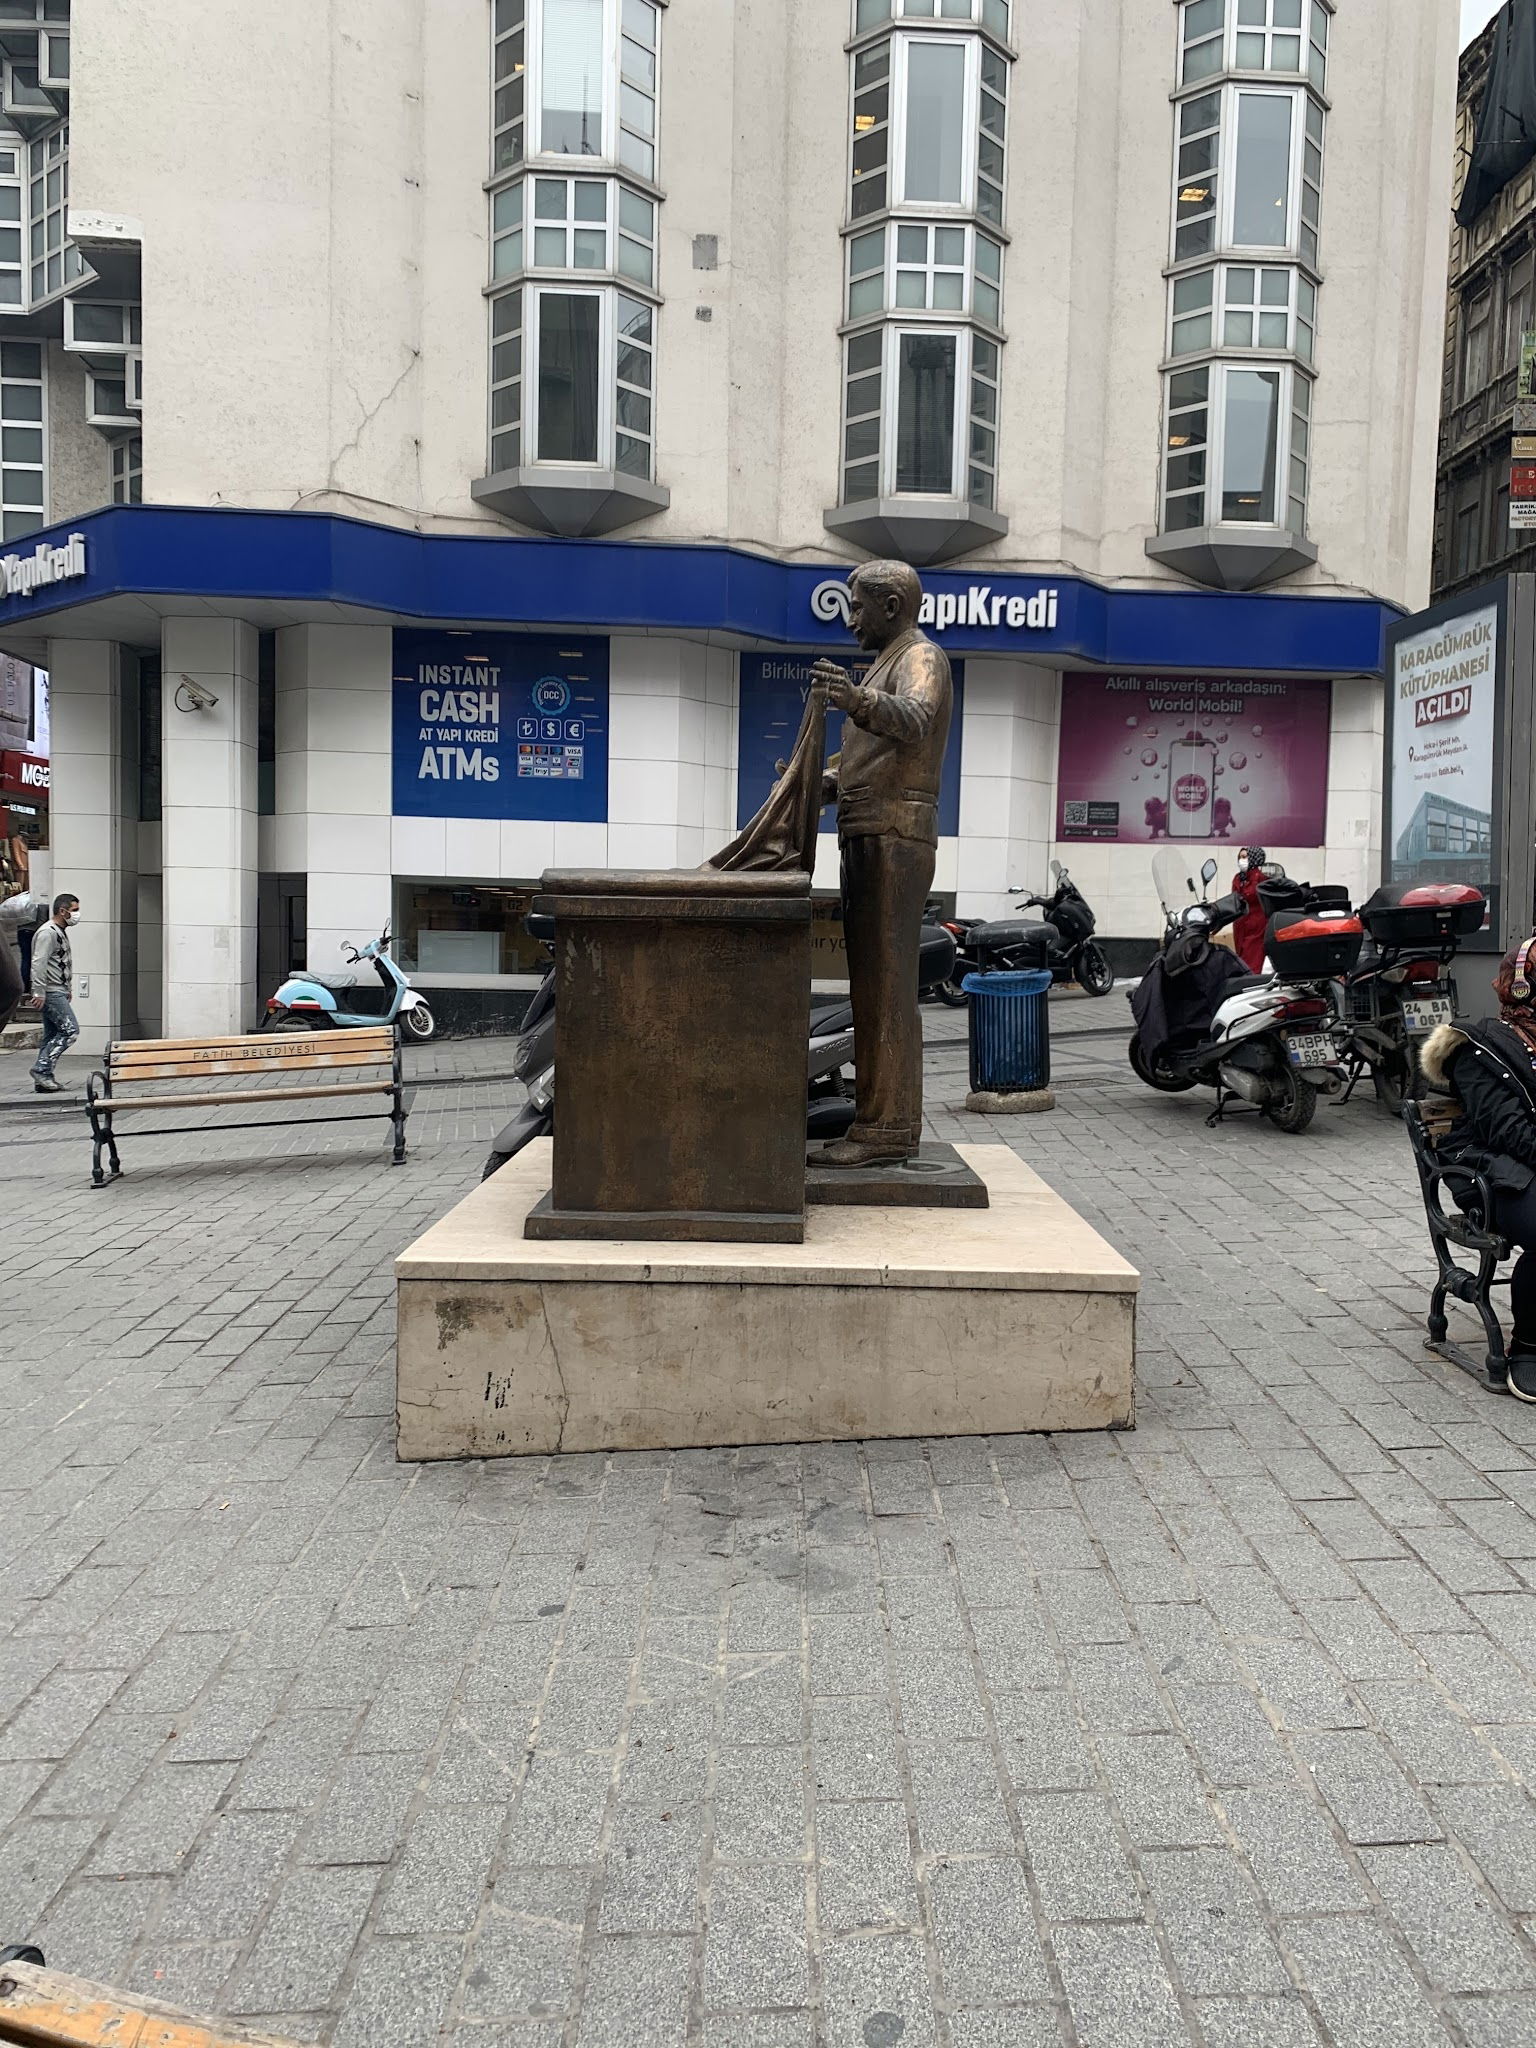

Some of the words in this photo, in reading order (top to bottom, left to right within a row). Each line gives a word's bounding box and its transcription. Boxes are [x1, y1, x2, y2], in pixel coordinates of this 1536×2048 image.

[918, 587, 1058, 630] apıKredi
[1400, 622, 1492, 673] KARAGÜMRÜK
[419, 664, 500, 686] INSTANT
[1400, 646, 1490, 699] KÜTÜPHANESİ
[1105, 677, 1141, 691] Akıllı
[543, 691, 560, 700] DCC
[420, 689, 500, 724] CASH
[1149, 698, 1194, 712] World
[1198, 698, 1243, 713] Mobil!
[1416, 689, 1469, 723] AÇILDI
[419, 727, 434, 740] AT
[436, 728, 461, 741] YAPI
[465, 727, 499, 743] KREDİ
[418, 746, 500, 782] ATMs
[1405, 1003, 1421, 1014] 24
[1432, 1001, 1449, 1013] BA
[1420, 1014, 1443, 1026] 067
[1304, 1050, 1327, 1062] 695
